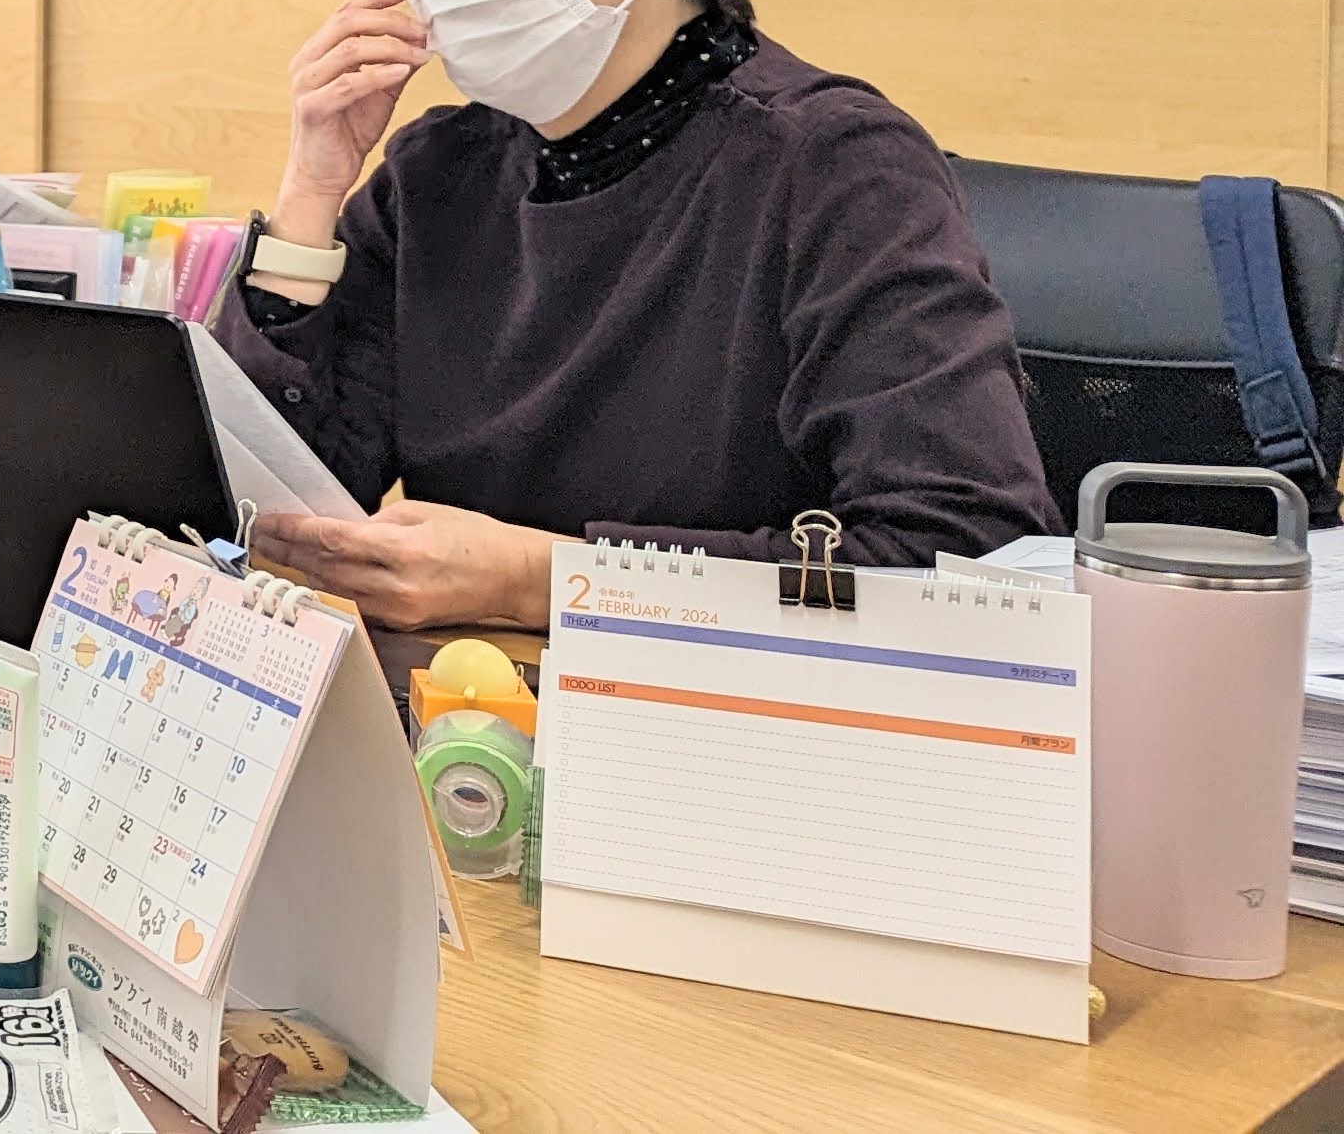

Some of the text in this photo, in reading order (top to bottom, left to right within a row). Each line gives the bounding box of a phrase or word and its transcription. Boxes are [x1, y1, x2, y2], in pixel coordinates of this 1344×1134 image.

[60, 546, 87, 596] 2
[567, 574, 591, 610] 2
[206, 601, 213, 614] 1
[598, 600, 719, 625] FEBRUARY 2024
[261, 624, 270, 638] 3
[567, 616, 599, 628] THEME
[75, 621, 86, 632] 29
[106, 636, 117, 648] 30
[139, 651, 150, 663] 31
[177, 669, 184, 684] 1
[212, 687, 222, 702] 2
[252, 706, 262, 722] 3
[1011, 667, 1070, 681] 今月のテーマ
[565, 679, 616, 693] TODO LIST
[272, 698, 281, 708] 土
[62, 668, 246, 774] 5 6 7 8 9 10
[46, 713, 227, 825] 12 13 14 15 16 17
[58, 777, 169, 855] 20 21 22 23
[44, 825, 57, 842] 27
[73, 845, 86, 863] 28
[103, 865, 117, 883] 29
[173, 909, 180, 922] 2
[191, 858, 207, 879] 24
[113, 1014, 128, 1034] TEL
